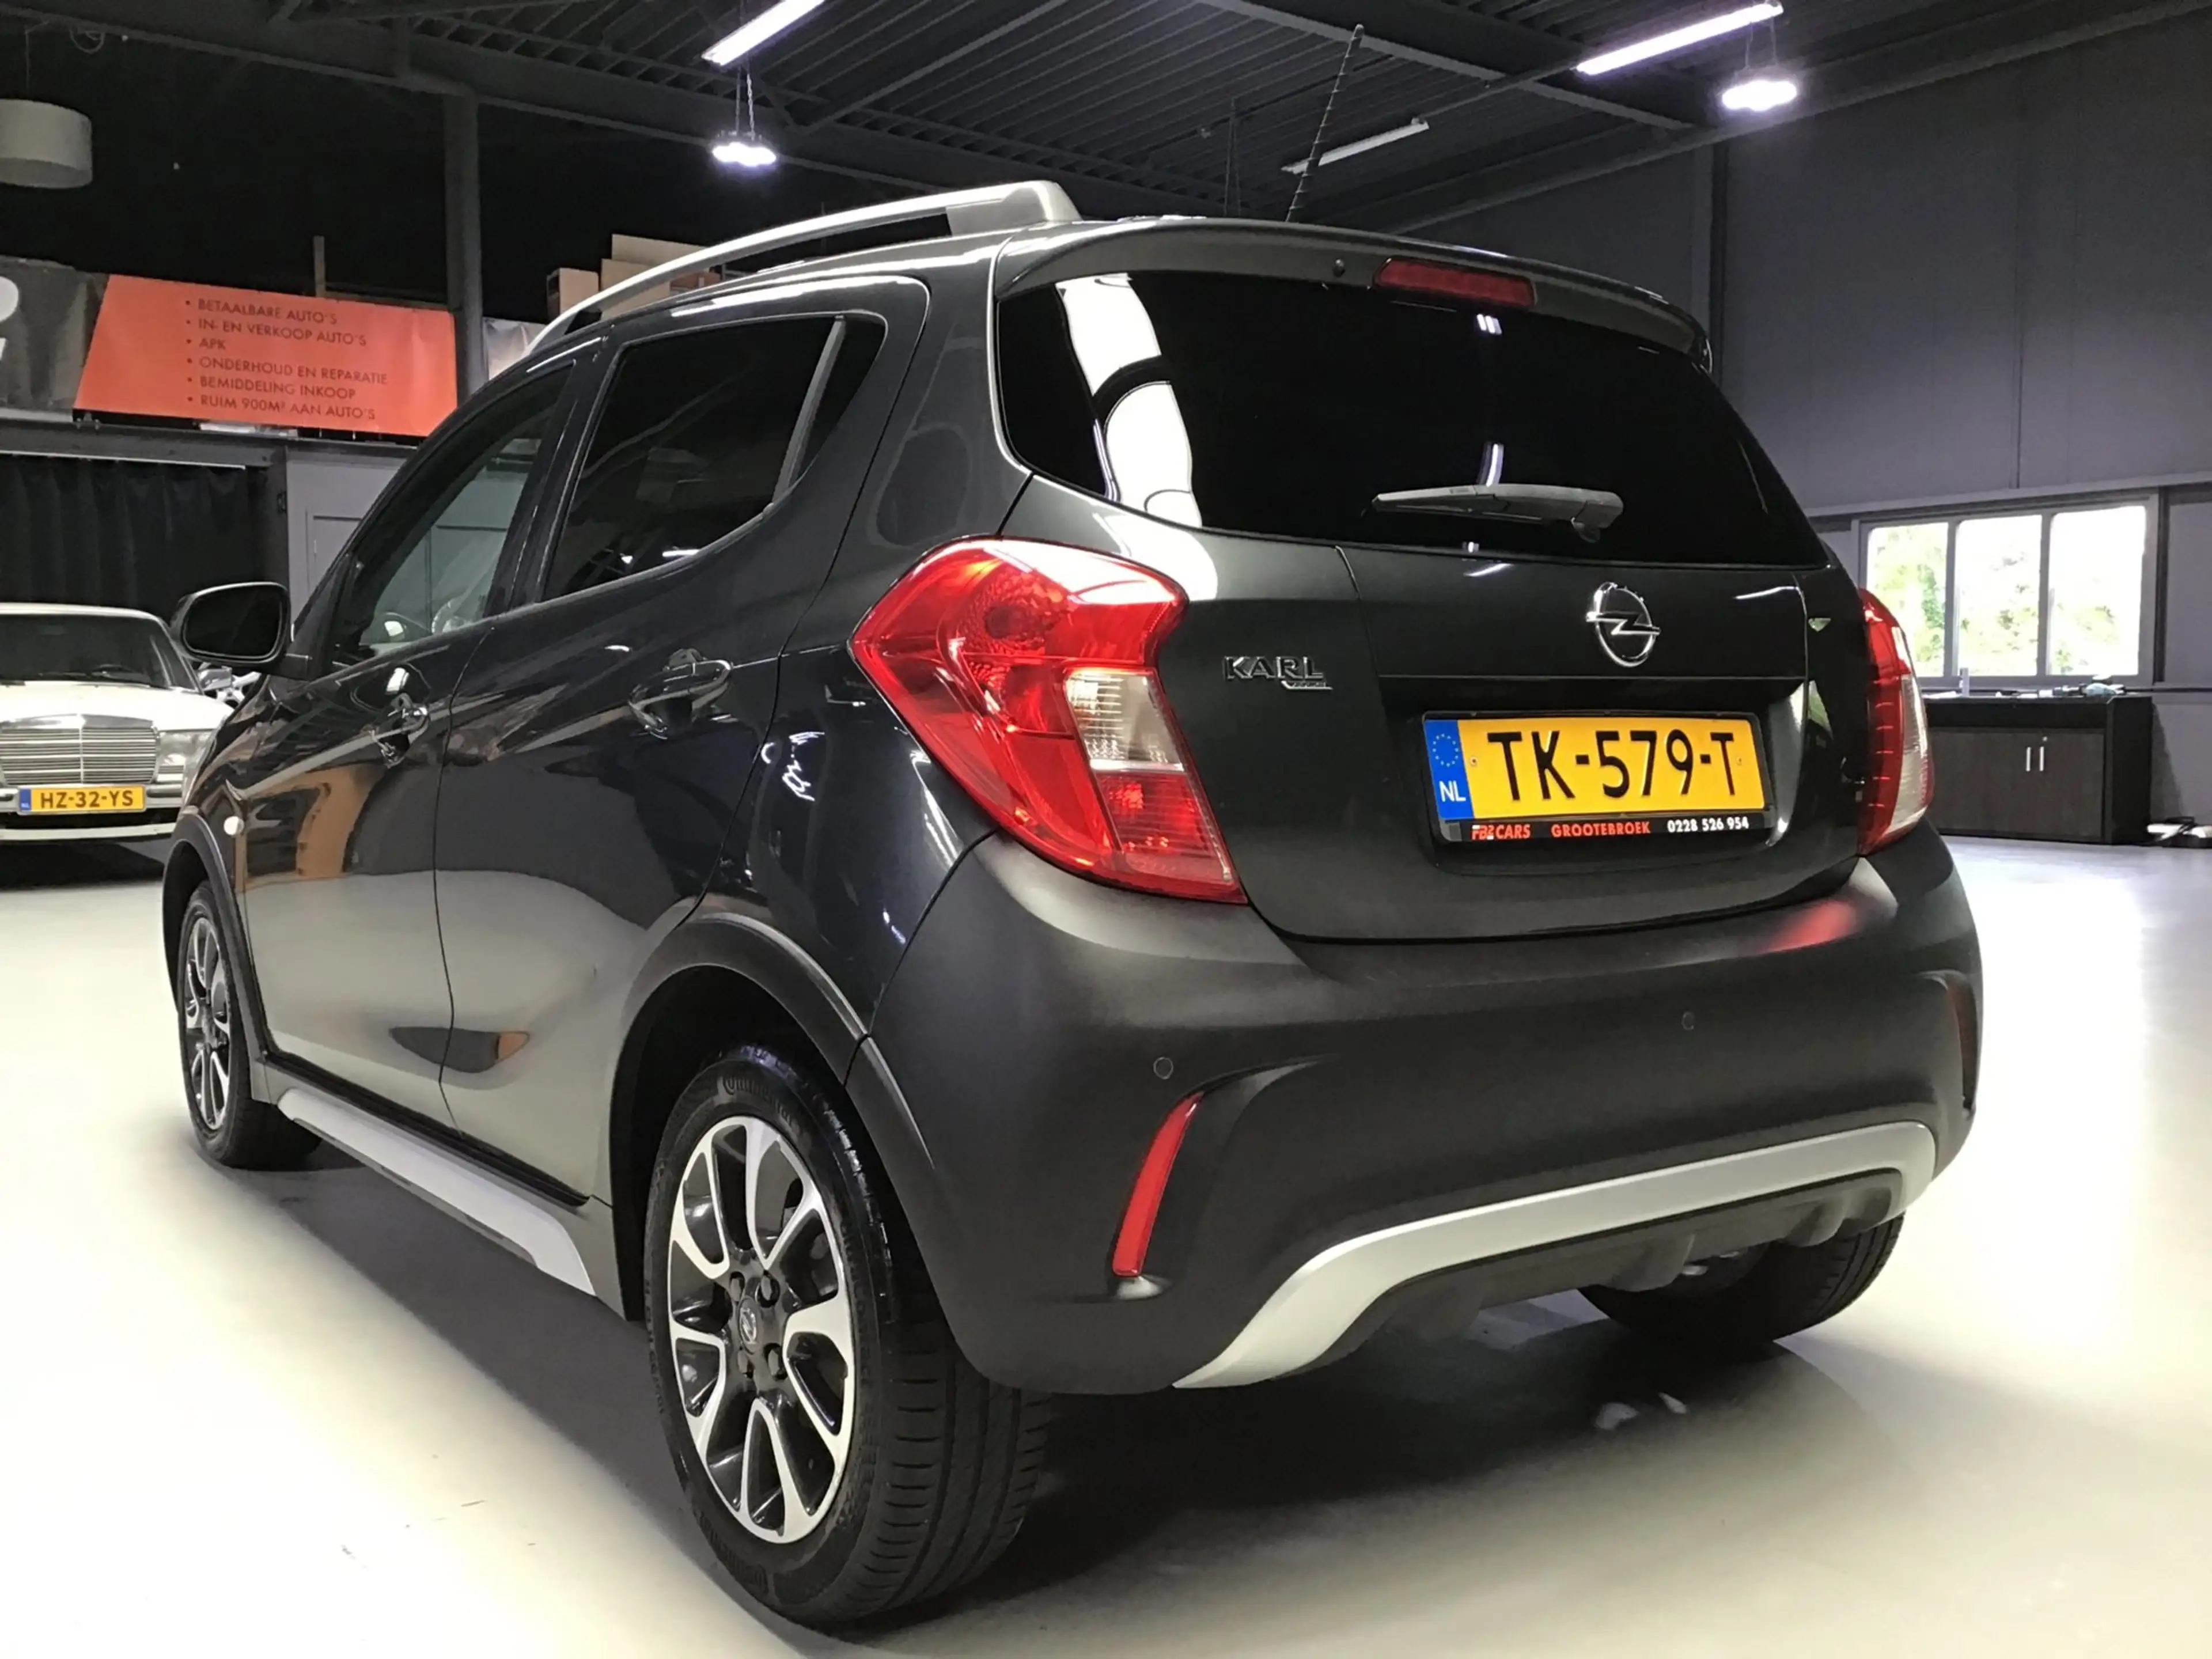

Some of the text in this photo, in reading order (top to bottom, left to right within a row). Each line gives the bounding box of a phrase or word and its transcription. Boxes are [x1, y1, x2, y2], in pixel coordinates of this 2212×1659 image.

[198, 298, 337, 325] BETAALBARE AUTO'S
[199, 338, 226, 350] APK
[223, 320, 241, 332] EN
[247, 323, 312, 340] VERKOOP
[317, 331, 366, 346] AUTO'S
[199, 356, 388, 384] ONDERHOUD EN REPARATIE
[200, 376, 356, 399] BEMIDDELING INKOOP
[200, 394, 237, 409] RUIM
[290, 403, 321, 415] AAN
[325, 406, 376, 419] AUTO'S
[1222, 656, 1324, 680] KARL
[1487, 729, 1736, 801] TK-579-T
[40, 790, 134, 809] HZ-32-YS
[1440, 781, 1467, 802] NL
[1551, 821, 1651, 838] GROOTEBROEK
[1667, 818, 1698, 833] 0228
[1702, 817, 1724, 831] 526
[1726, 816, 1749, 830] 954
